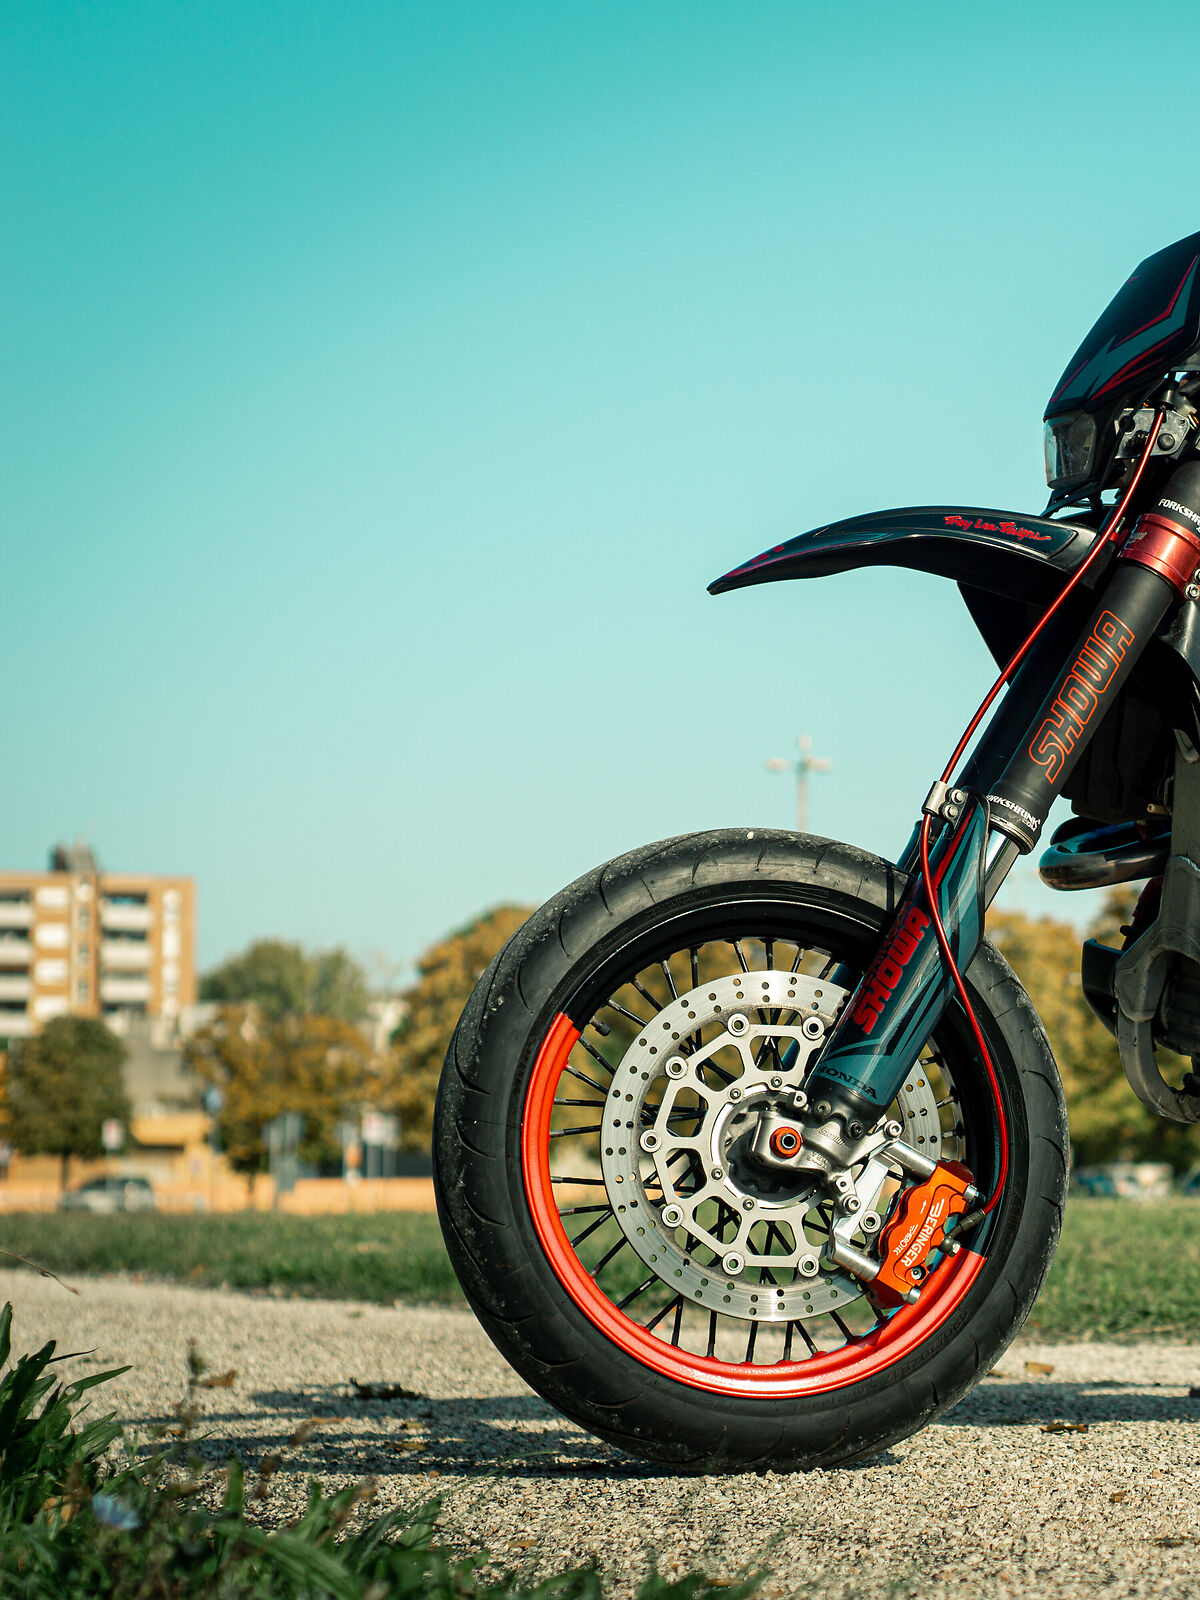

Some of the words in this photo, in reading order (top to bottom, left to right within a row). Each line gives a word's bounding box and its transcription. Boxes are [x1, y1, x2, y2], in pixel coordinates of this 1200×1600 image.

[944, 515, 973, 531] Troy
[974, 518, 999, 531] Lee
[1028, 610, 1136, 785] SHOWA
[852, 906, 932, 1036] SHOWA
[816, 1065, 878, 1100] HONDA
[900, 1198, 945, 1267] BERINGER
